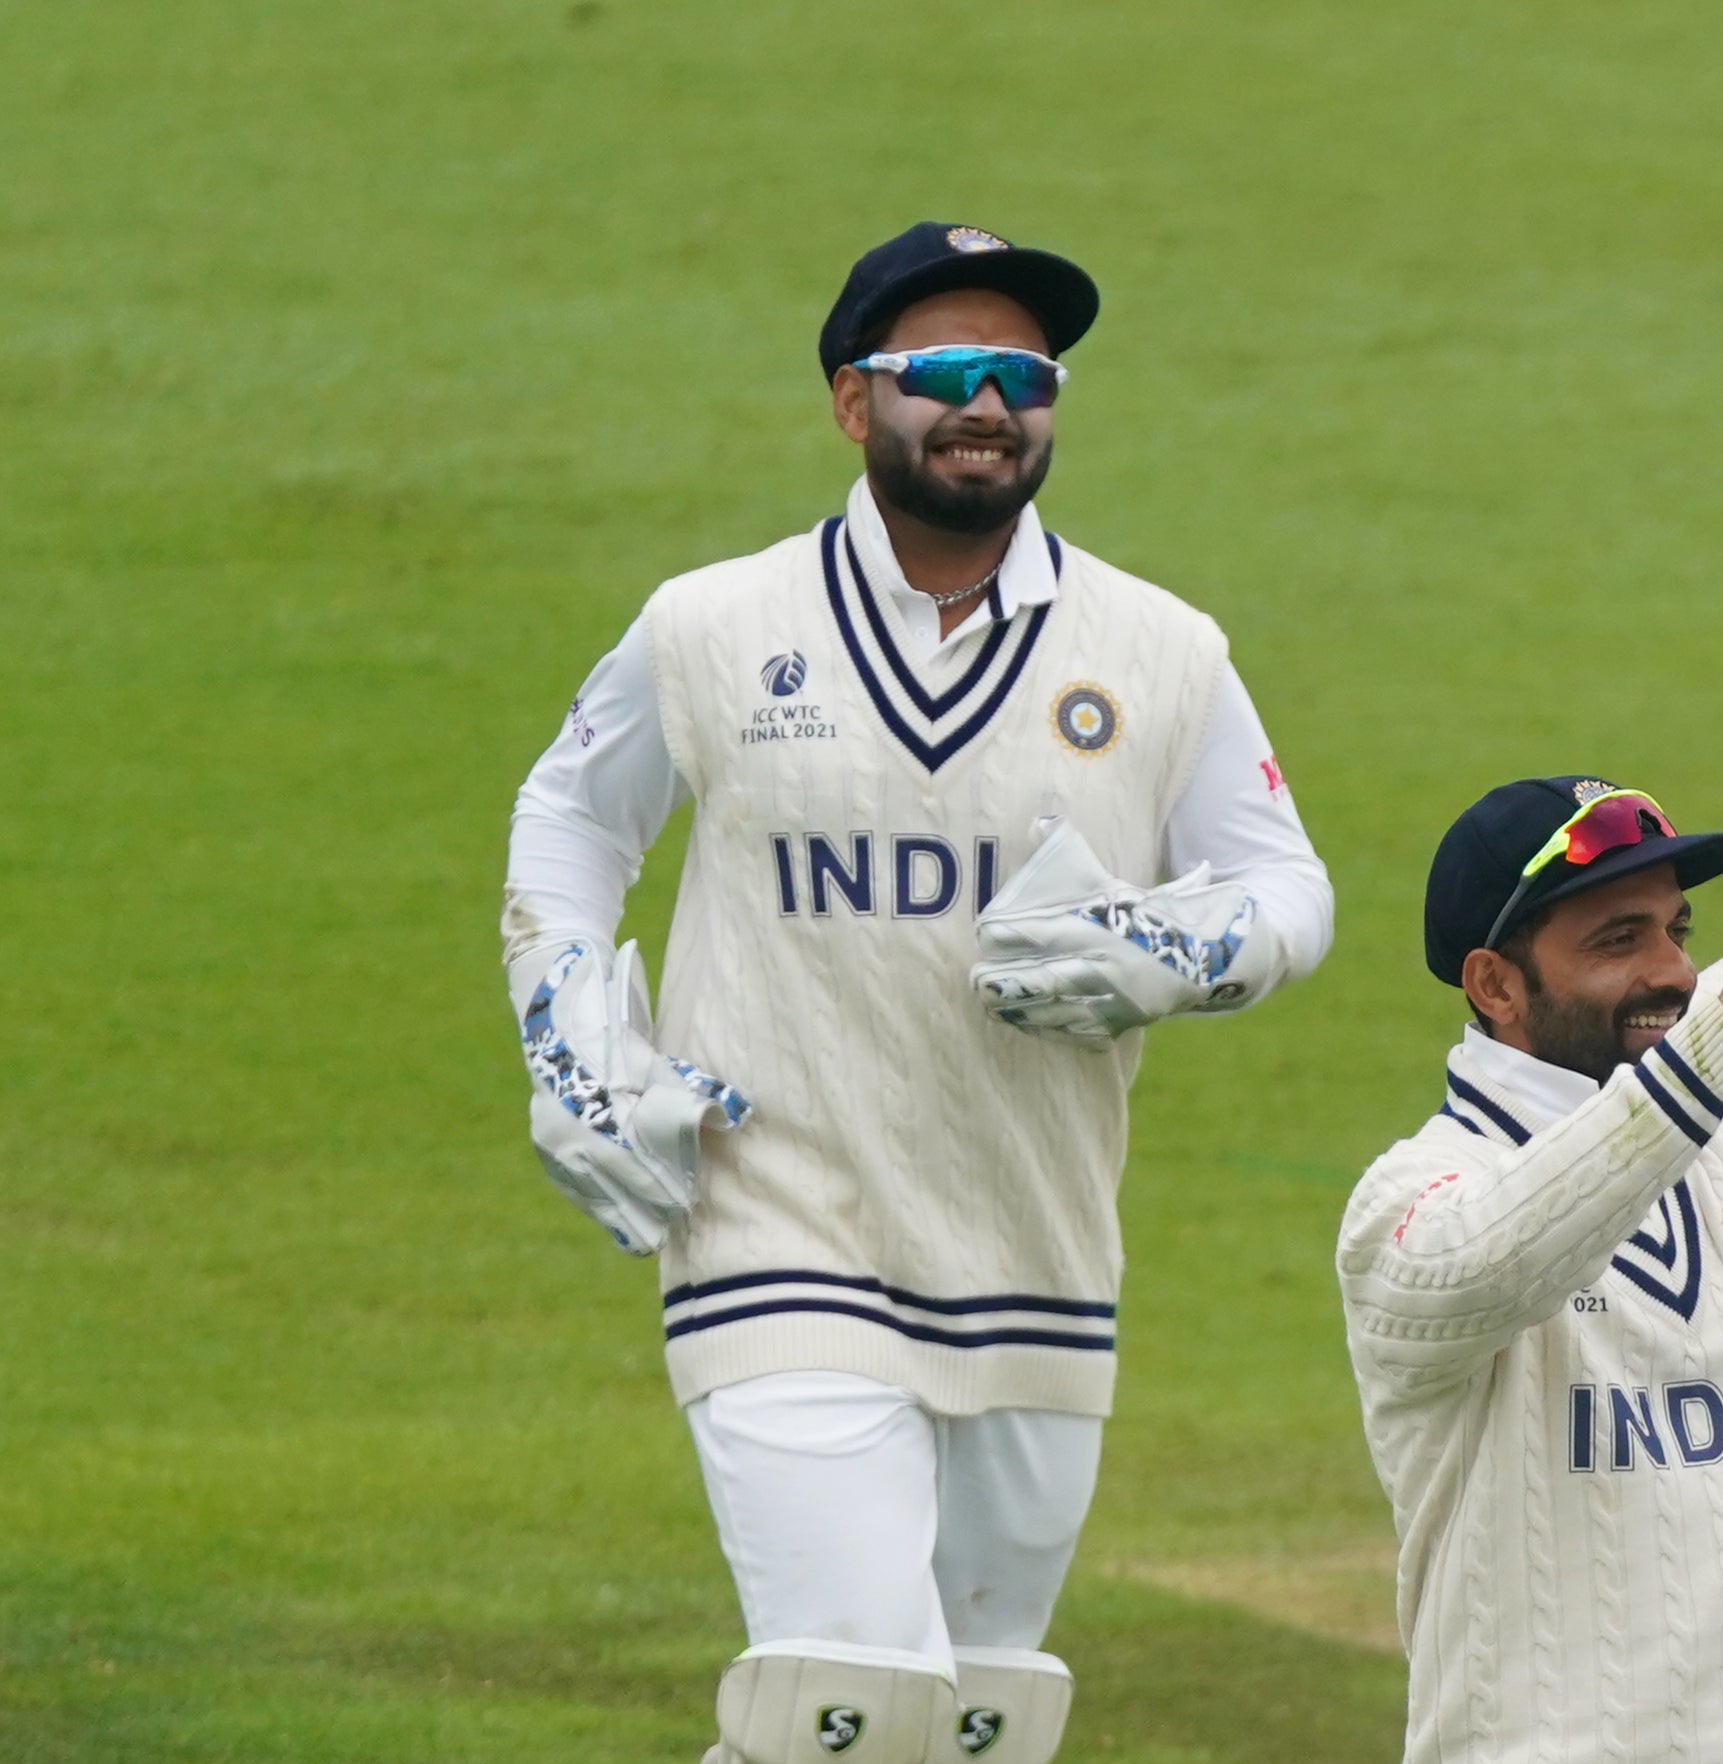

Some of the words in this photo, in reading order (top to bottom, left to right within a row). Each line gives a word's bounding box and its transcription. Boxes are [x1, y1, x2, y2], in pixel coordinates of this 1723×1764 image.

[753, 706, 777, 724] ICC
[781, 704, 821, 720] WTC
[741, 725, 790, 744] FINAL
[793, 723, 837, 738] 2021
[769, 830, 1000, 922] INDI
[1570, 1296, 1609, 1313] 021
